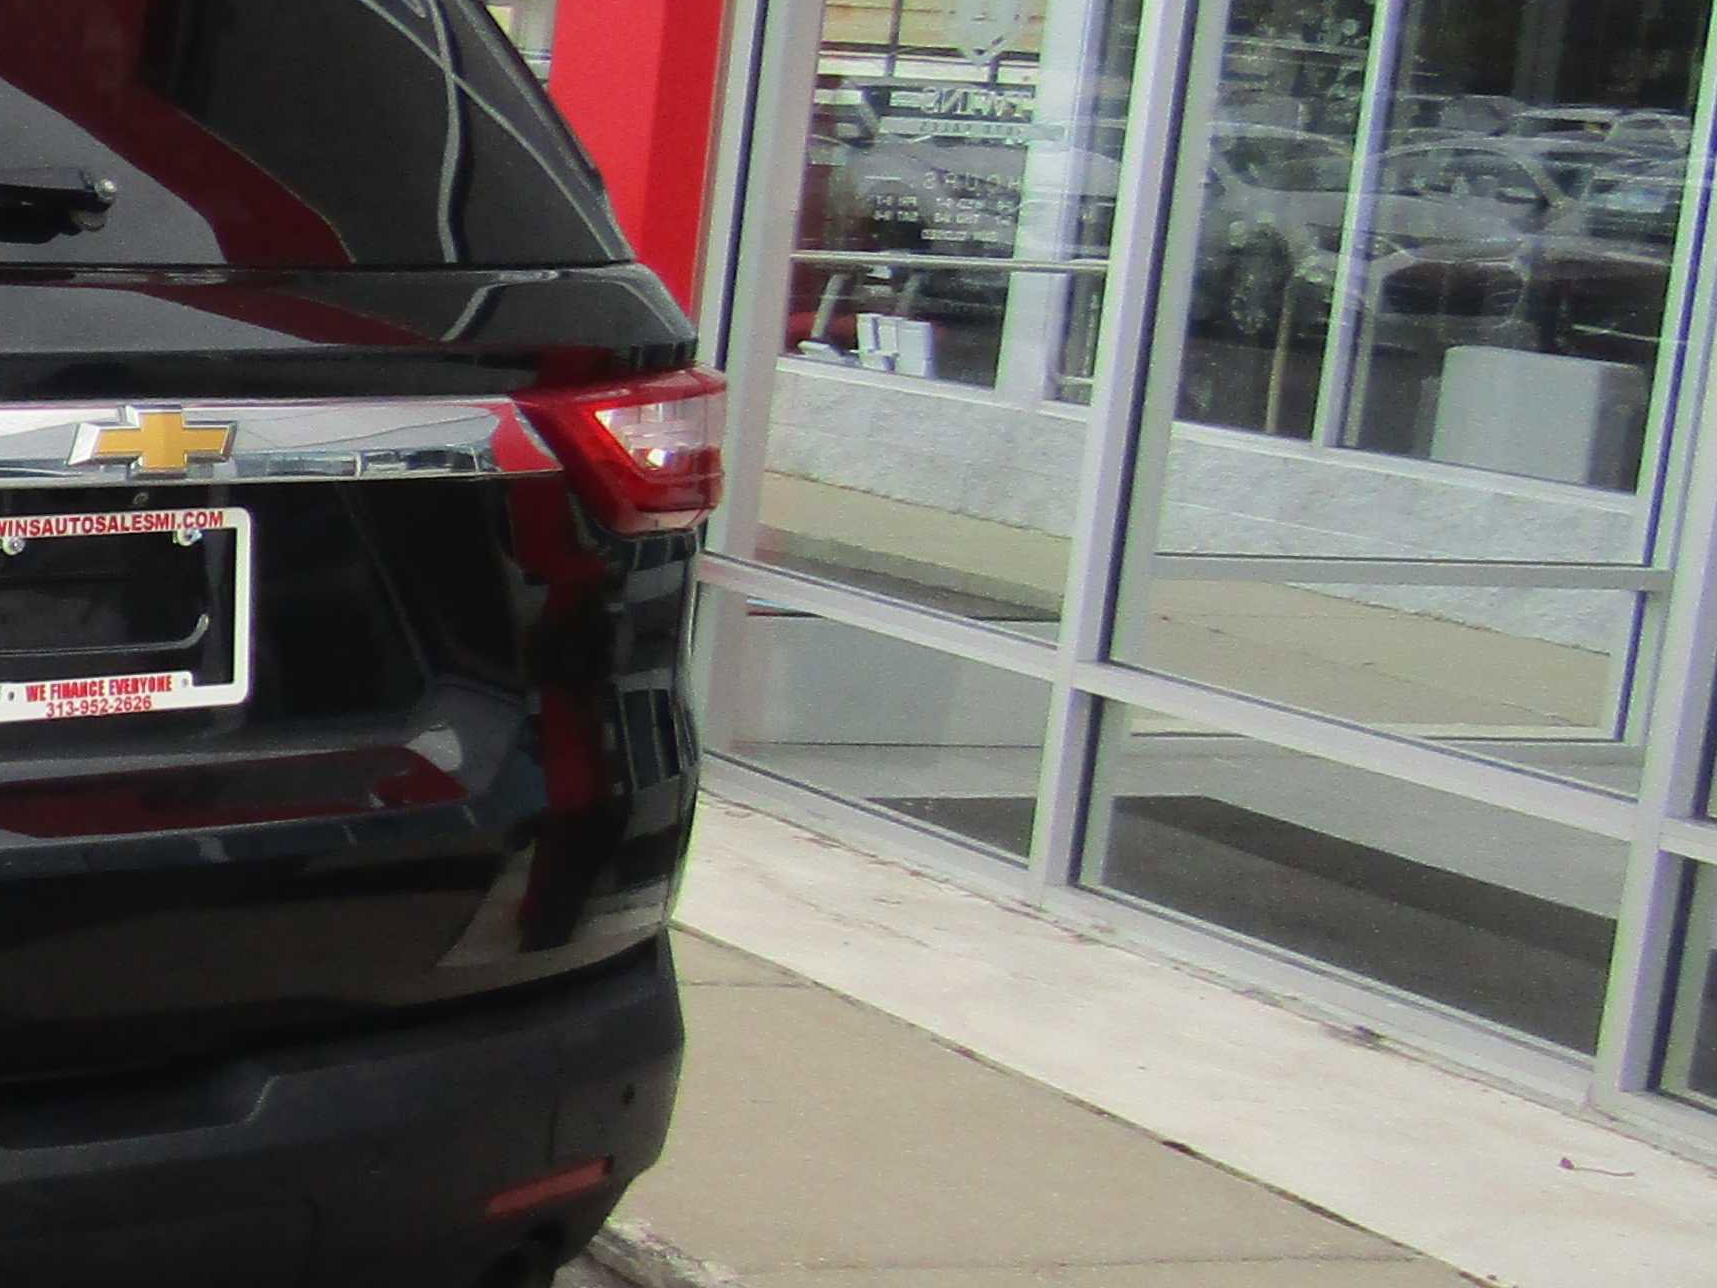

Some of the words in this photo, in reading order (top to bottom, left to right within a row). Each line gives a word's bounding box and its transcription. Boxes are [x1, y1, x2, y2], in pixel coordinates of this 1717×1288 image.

[25, 684, 46, 702] WE
[50, 679, 105, 700] FINANCE
[108, 675, 173, 696] EVERYONE
[45, 695, 153, 719] 313-952-2626
